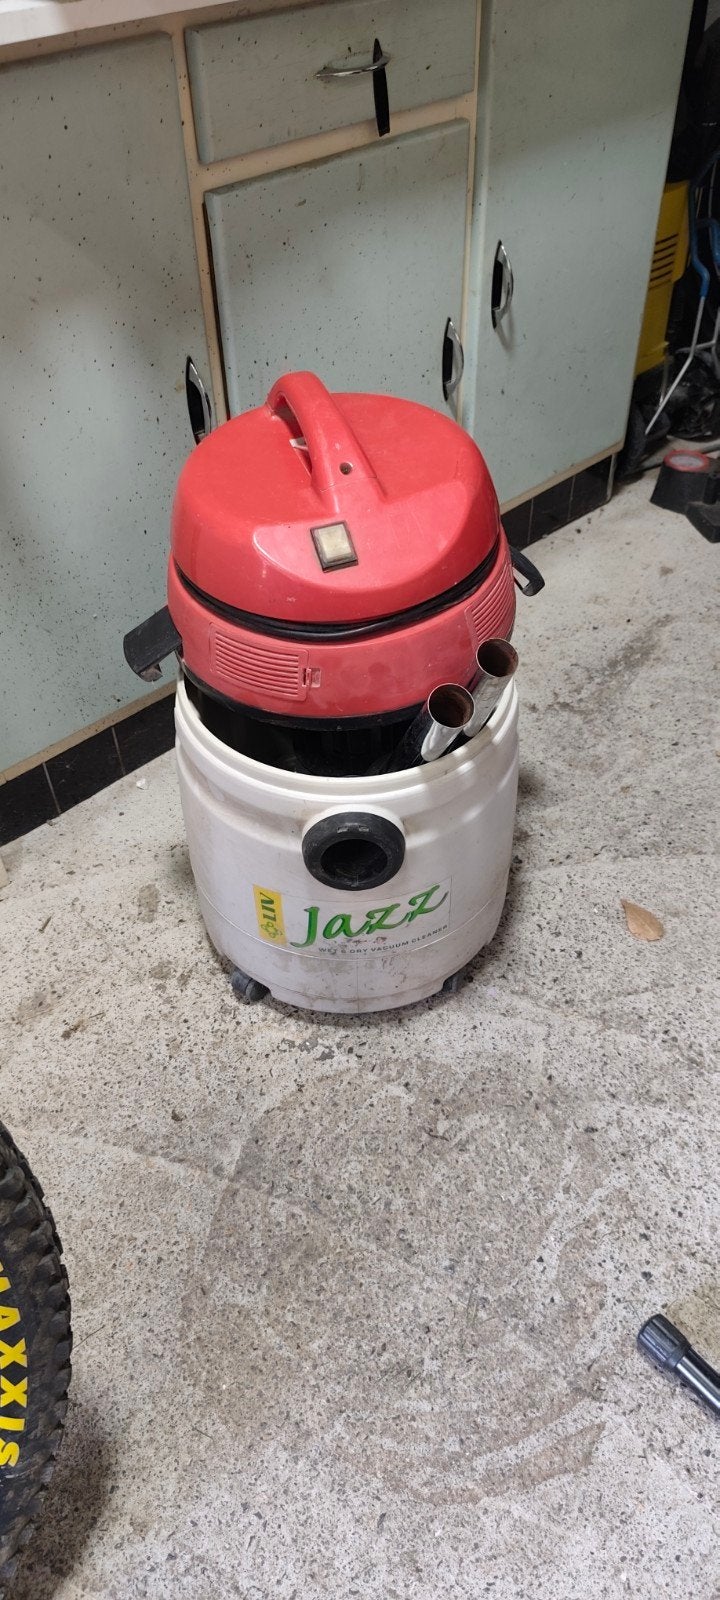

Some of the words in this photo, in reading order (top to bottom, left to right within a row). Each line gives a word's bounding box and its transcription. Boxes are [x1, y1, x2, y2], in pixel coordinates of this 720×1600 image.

[289, 884, 449, 948] Jazz
[371, 940, 409, 952] VACUUM
[411, 924, 448, 943] CLEANER
